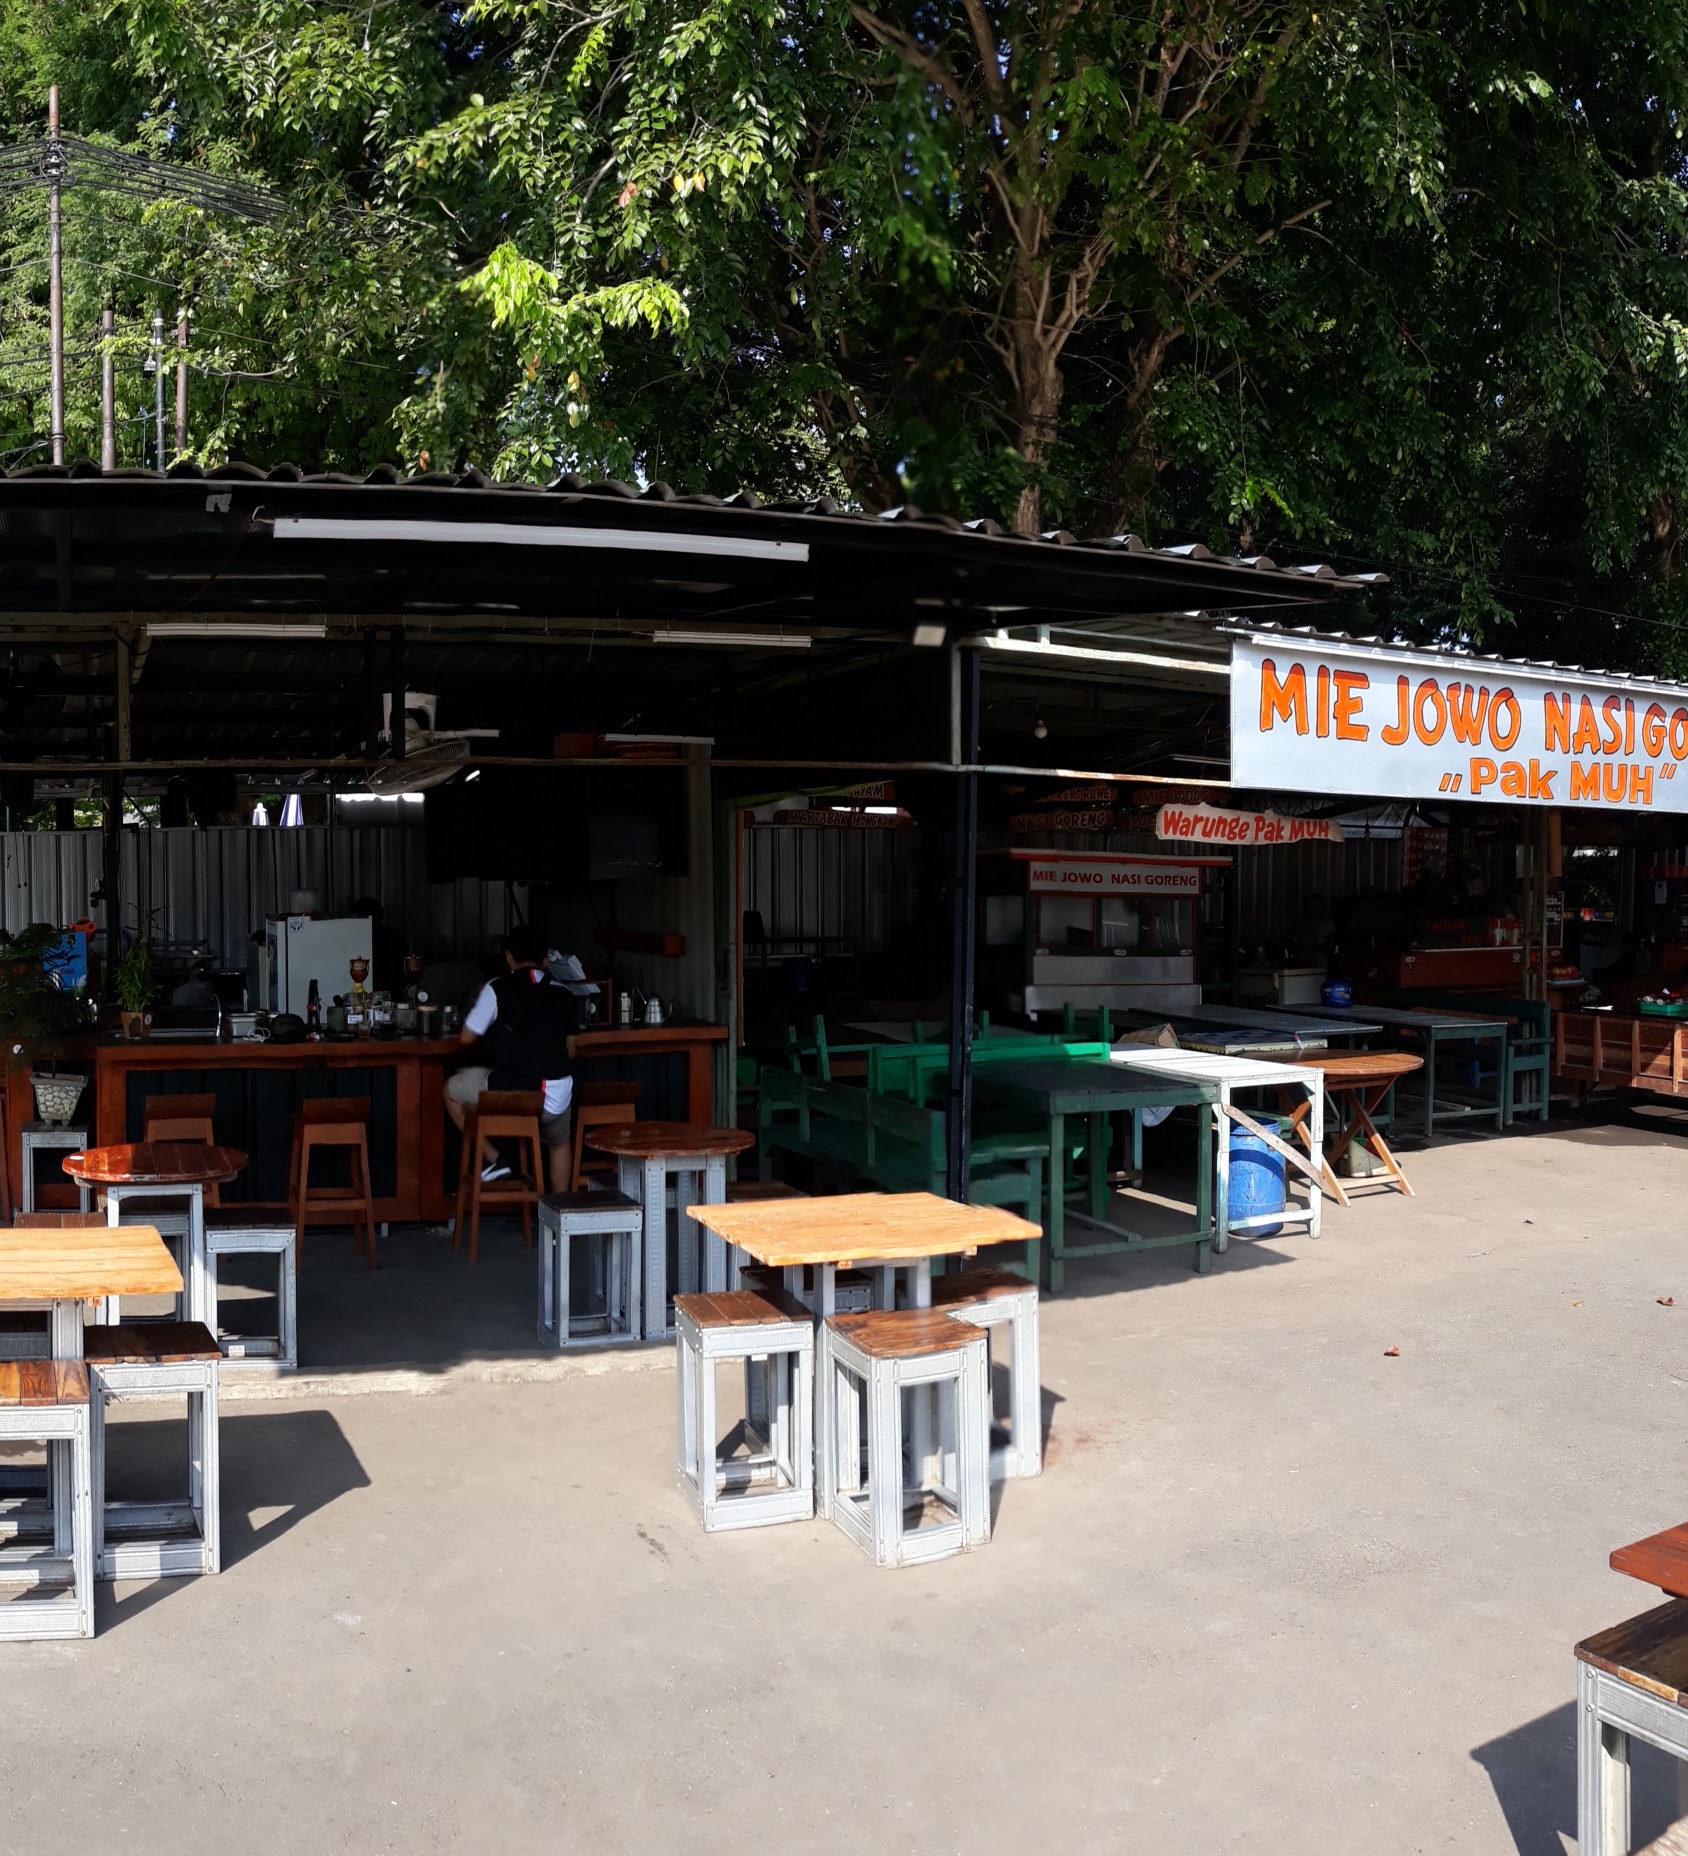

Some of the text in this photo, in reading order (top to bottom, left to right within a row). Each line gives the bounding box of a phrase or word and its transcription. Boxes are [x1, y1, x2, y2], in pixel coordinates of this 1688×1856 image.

[1259, 658, 1370, 742] MIE
[1381, 674, 1521, 752] JOWO
[1545, 691, 1635, 756] NASI
[1055, 810, 1106, 829] GORENG
[1163, 809, 1330, 842] Warunge Pak MUH
[1032, 870, 1197, 886] MIE JOWO NASI GORENG
